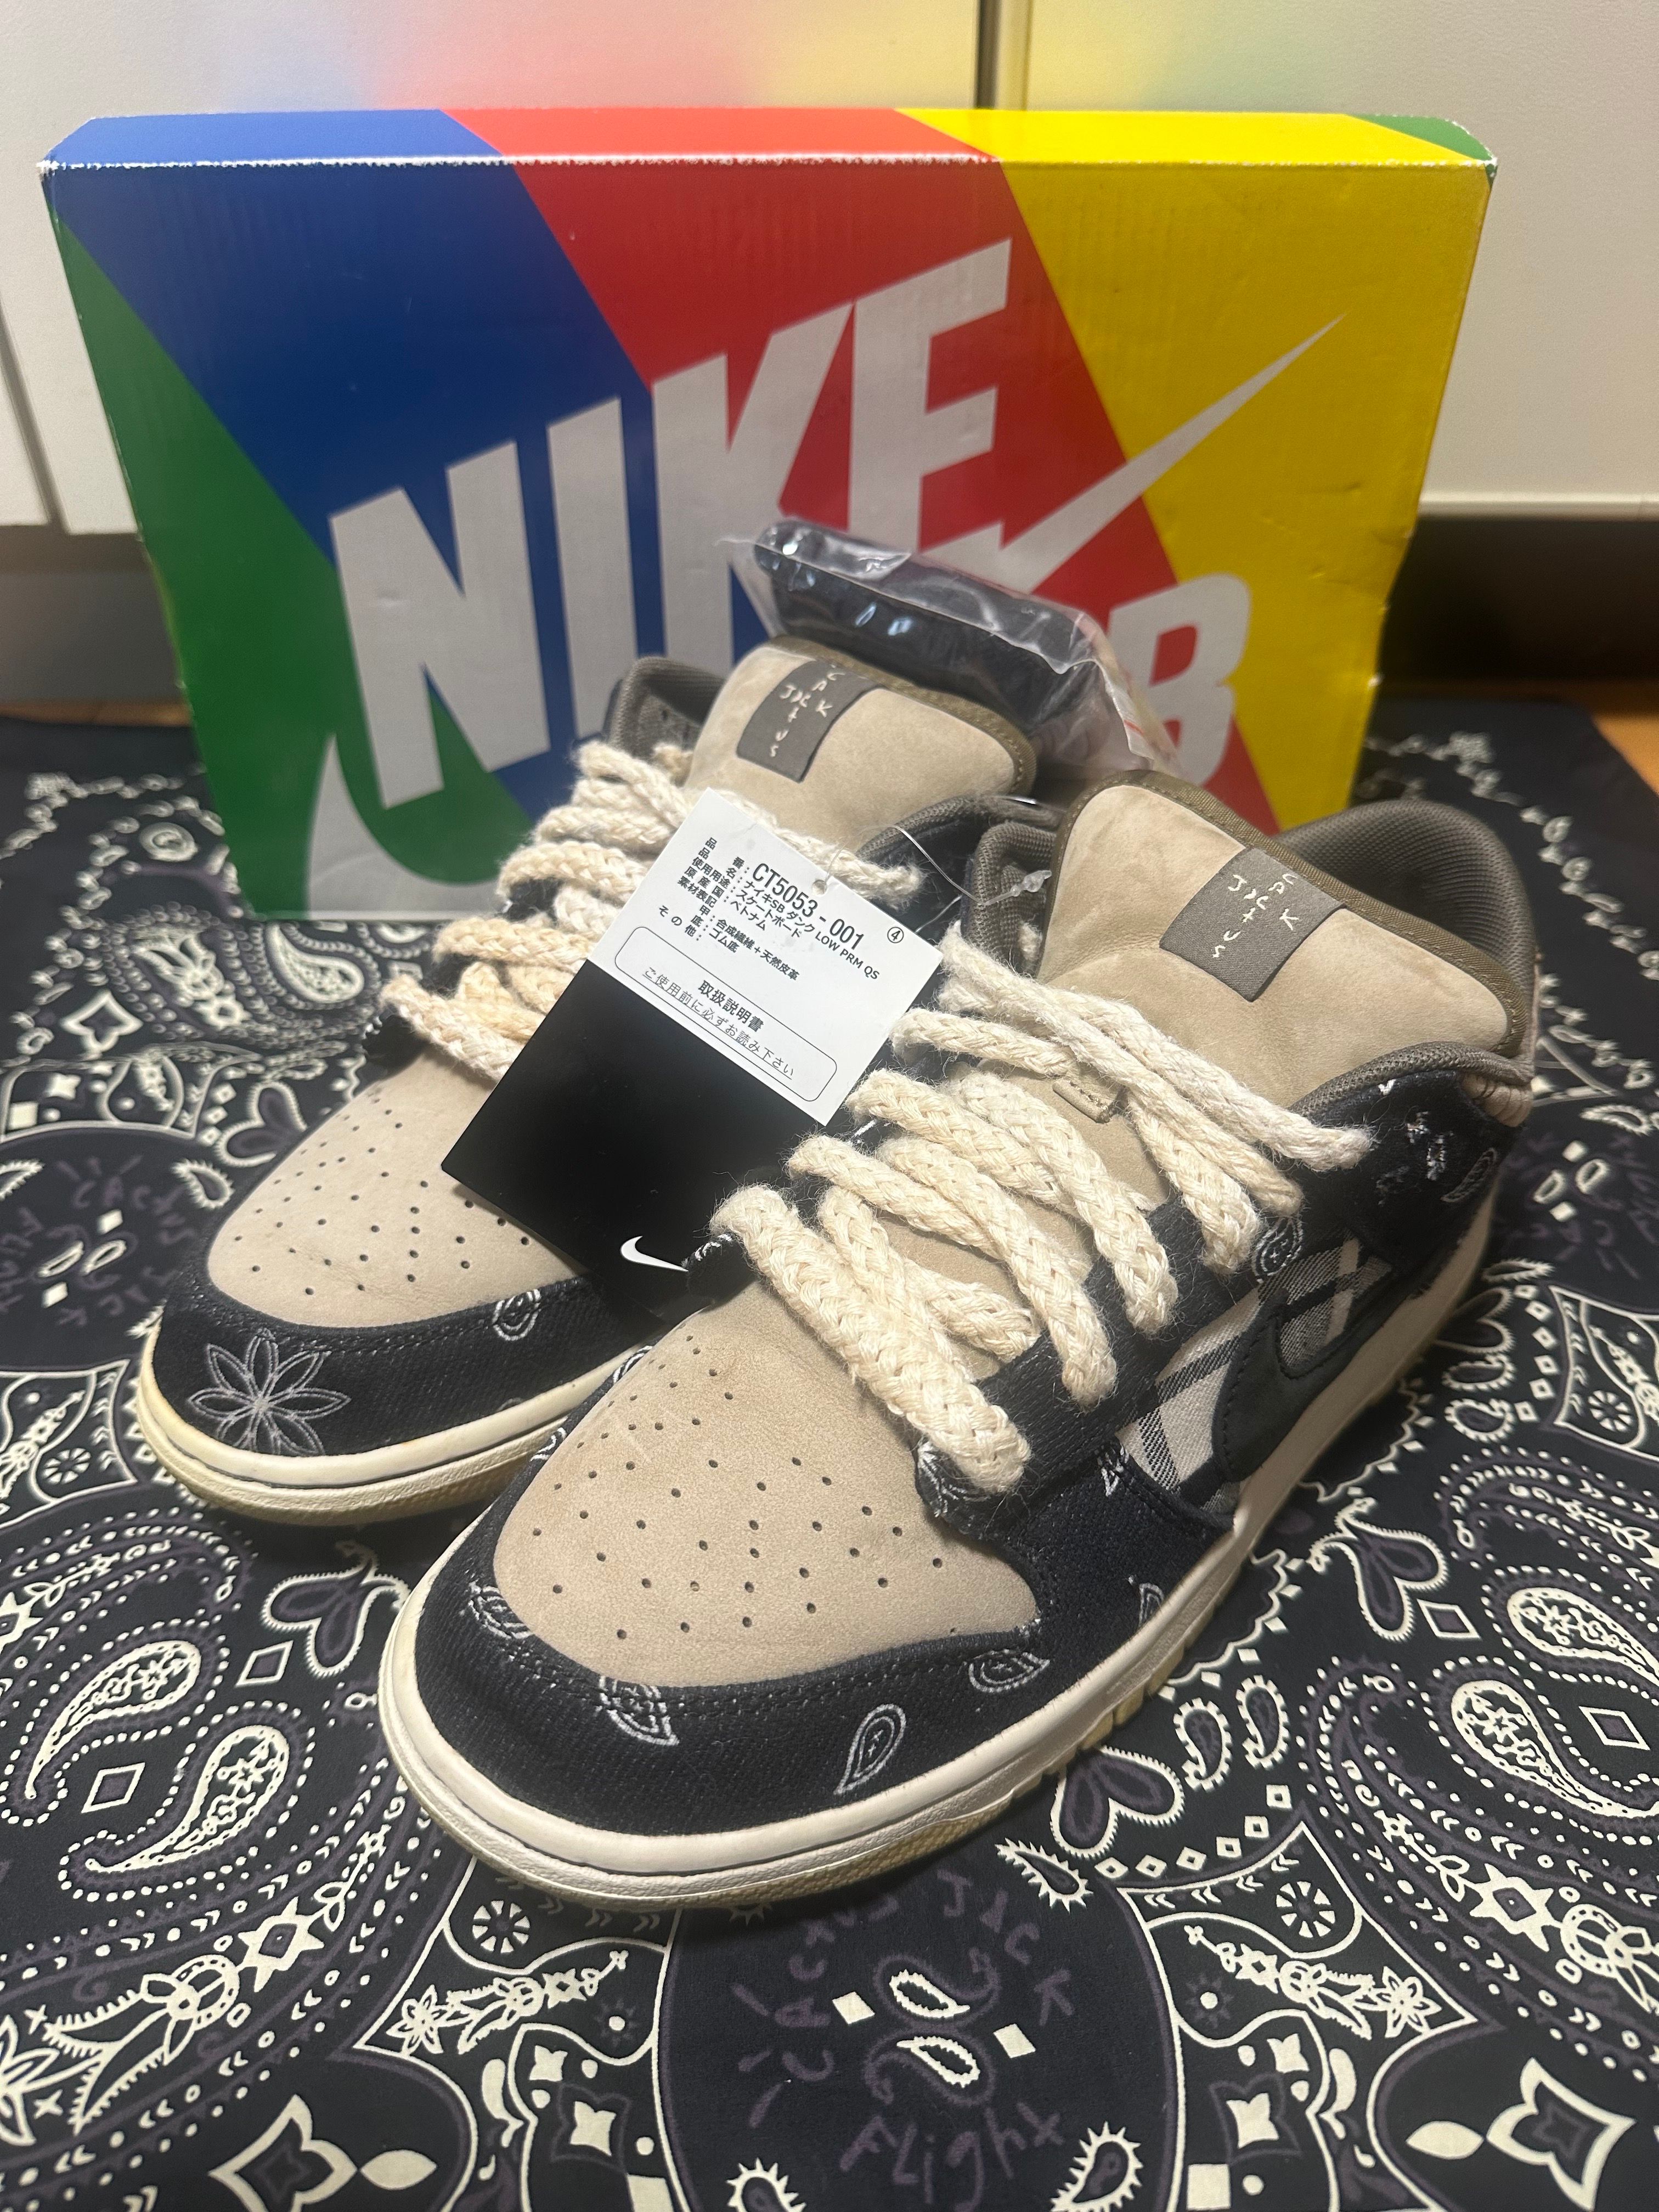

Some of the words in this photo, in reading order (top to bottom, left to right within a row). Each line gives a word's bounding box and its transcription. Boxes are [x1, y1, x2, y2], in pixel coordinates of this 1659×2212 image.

[329, 238, 1013, 808] NIKE
[708, 928, 740, 953] ゴム底
[730, 900, 765, 930] ベトナム
[735, 889, 802, 938] スケートボード
[743, 880, 785, 913] ナイキSB
[786, 911, 815, 932] ダンク
[815, 931, 840, 951] LOW
[839, 948, 864, 968] PRM
[864, 966, 879, 979] QS
[752, 863, 818, 917] CT5053
[829, 918, 864, 950] 001
[642, 967, 793, 1076] ご使用前に必ずお読み下さい
[698, 980, 764, 1032] 取扱説明書
